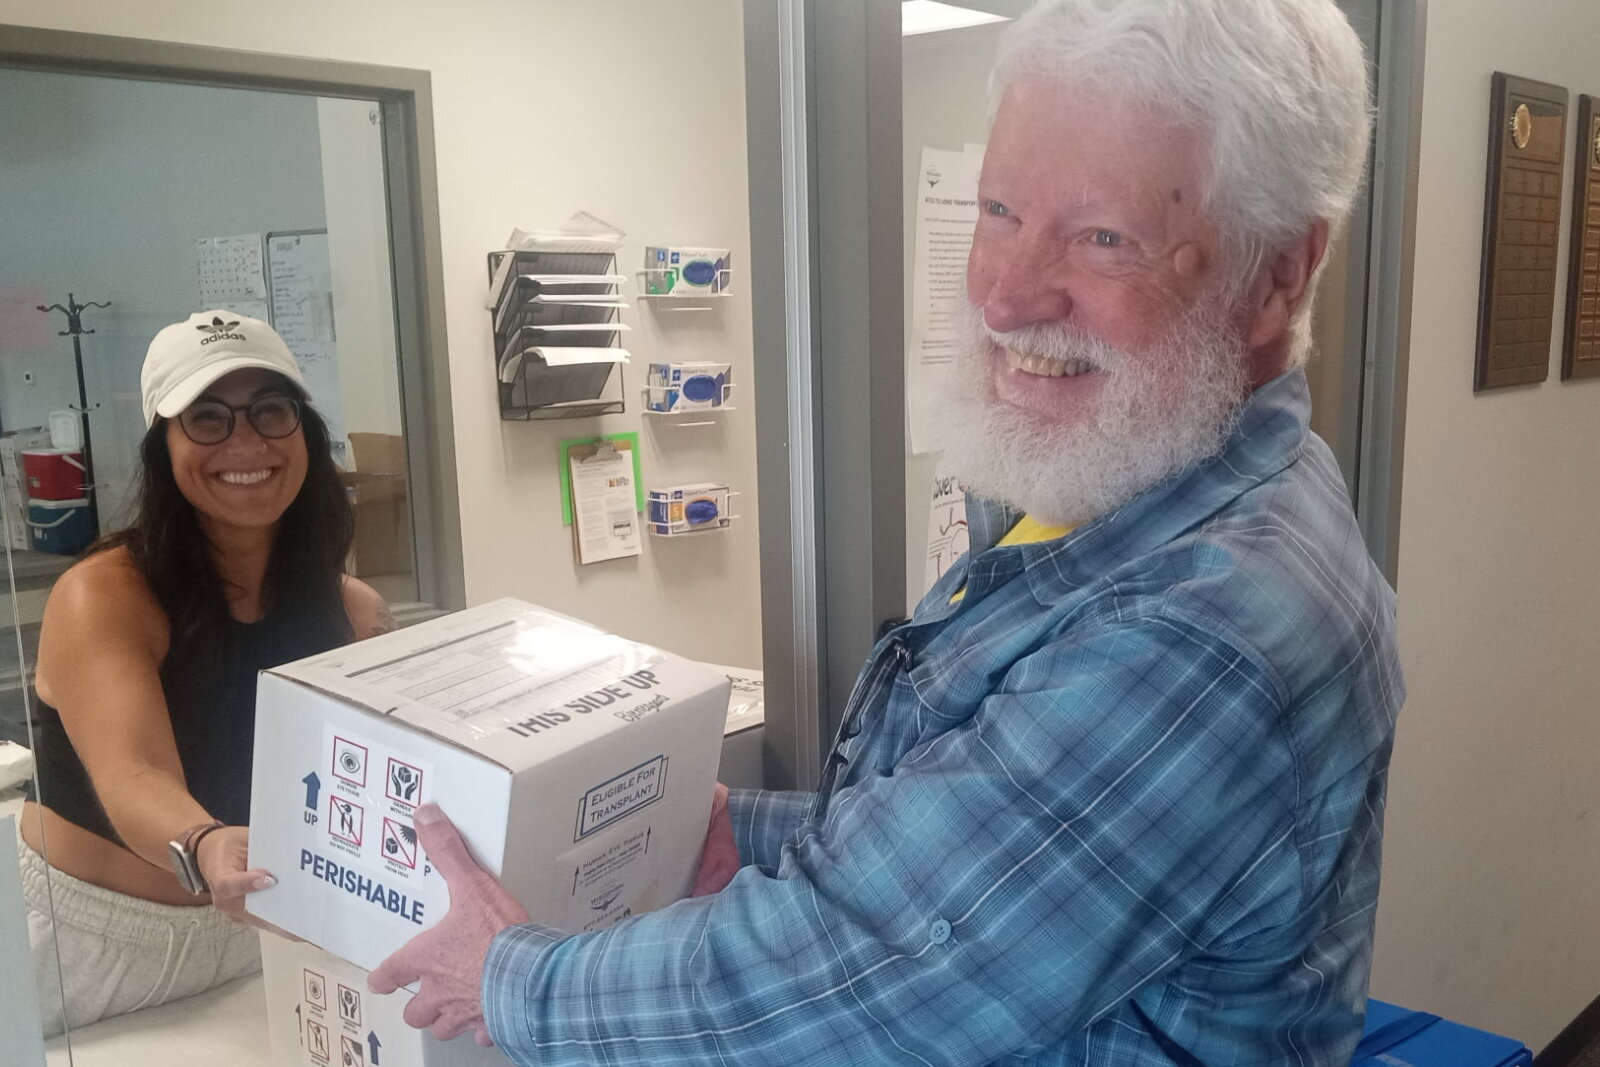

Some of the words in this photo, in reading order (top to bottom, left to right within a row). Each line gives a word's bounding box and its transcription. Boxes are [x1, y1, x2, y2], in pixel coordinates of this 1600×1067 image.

[200, 332, 246, 346] adidas
[507, 709, 571, 738] THIS
[564, 685, 632, 714] SIDE
[622, 670, 660, 690] UP
[303, 811, 319, 827] UP
[590, 783, 653, 823] TRANSPLANT
[300, 848, 425, 926] PERISHABLE
